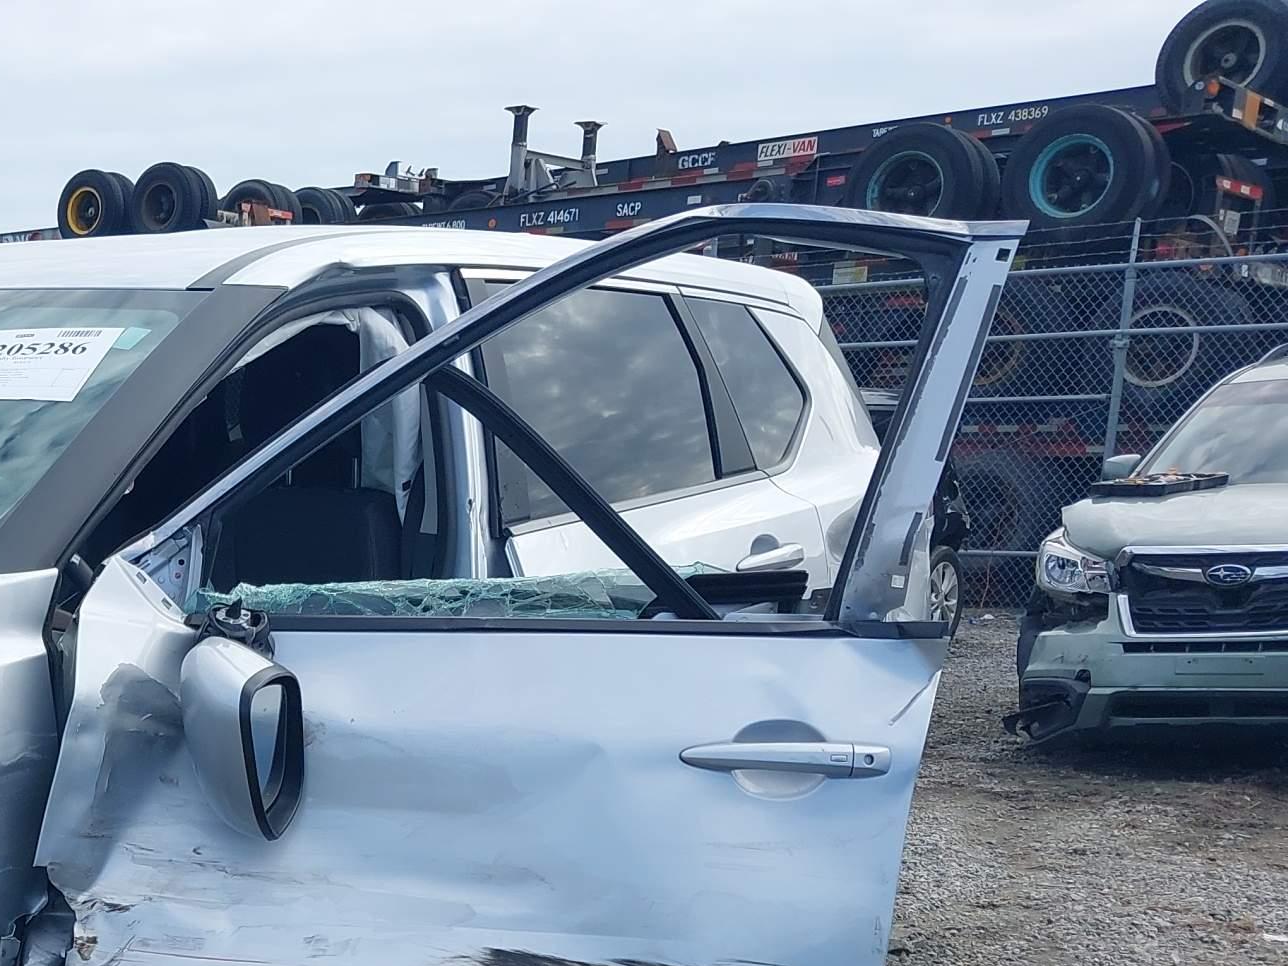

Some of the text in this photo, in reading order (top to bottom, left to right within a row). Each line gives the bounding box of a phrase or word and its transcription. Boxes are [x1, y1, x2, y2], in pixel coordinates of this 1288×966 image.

[977, 105, 1049, 126] FLXZ 438369
[758, 138, 817, 159] FLEXI-VAN
[519, 207, 579, 227] FLXZ 414671
[616, 201, 642, 217] SACP
